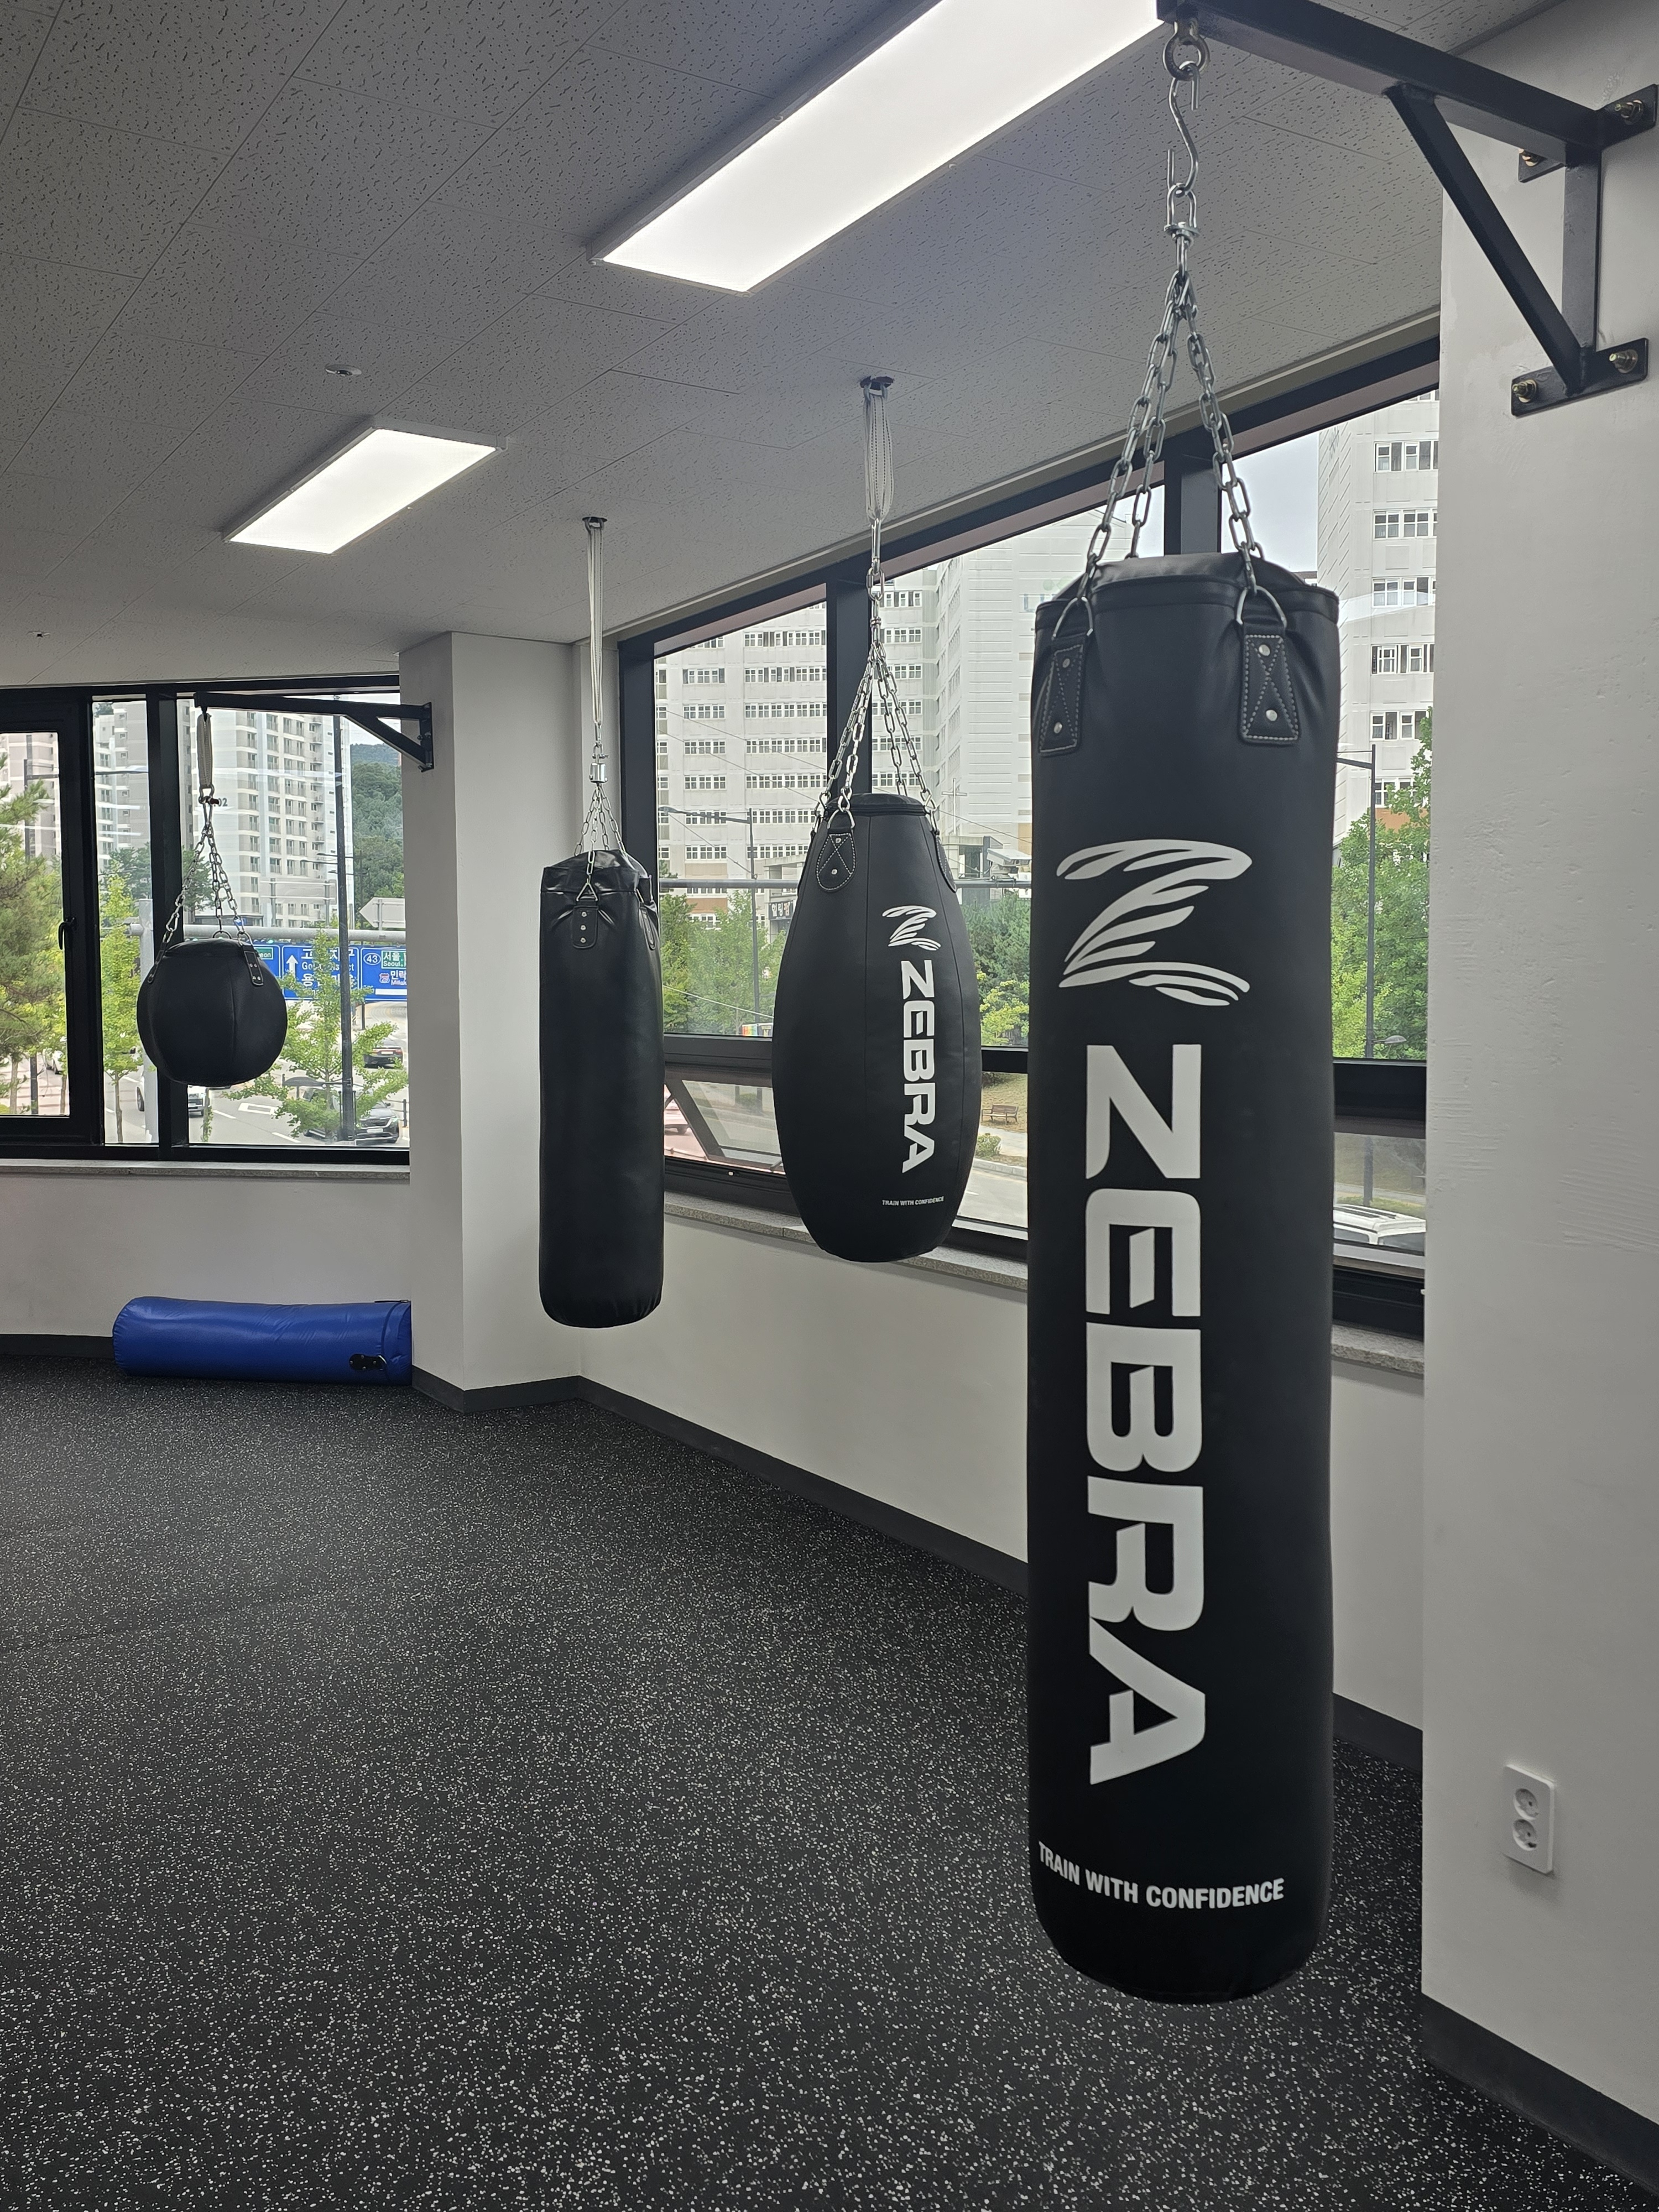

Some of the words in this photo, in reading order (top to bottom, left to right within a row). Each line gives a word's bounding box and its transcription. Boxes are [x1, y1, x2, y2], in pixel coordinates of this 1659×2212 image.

[900, 959, 936, 1173] ZEBRA
[915, 1196, 945, 1206] CONFIDENCE
[1086, 1044, 1206, 1785] ZEBRA
[1039, 1841, 1080, 1885] TRAIN
[1085, 1869, 1138, 1903] WITH
[1146, 1877, 1285, 1909] CONFIDENCE
